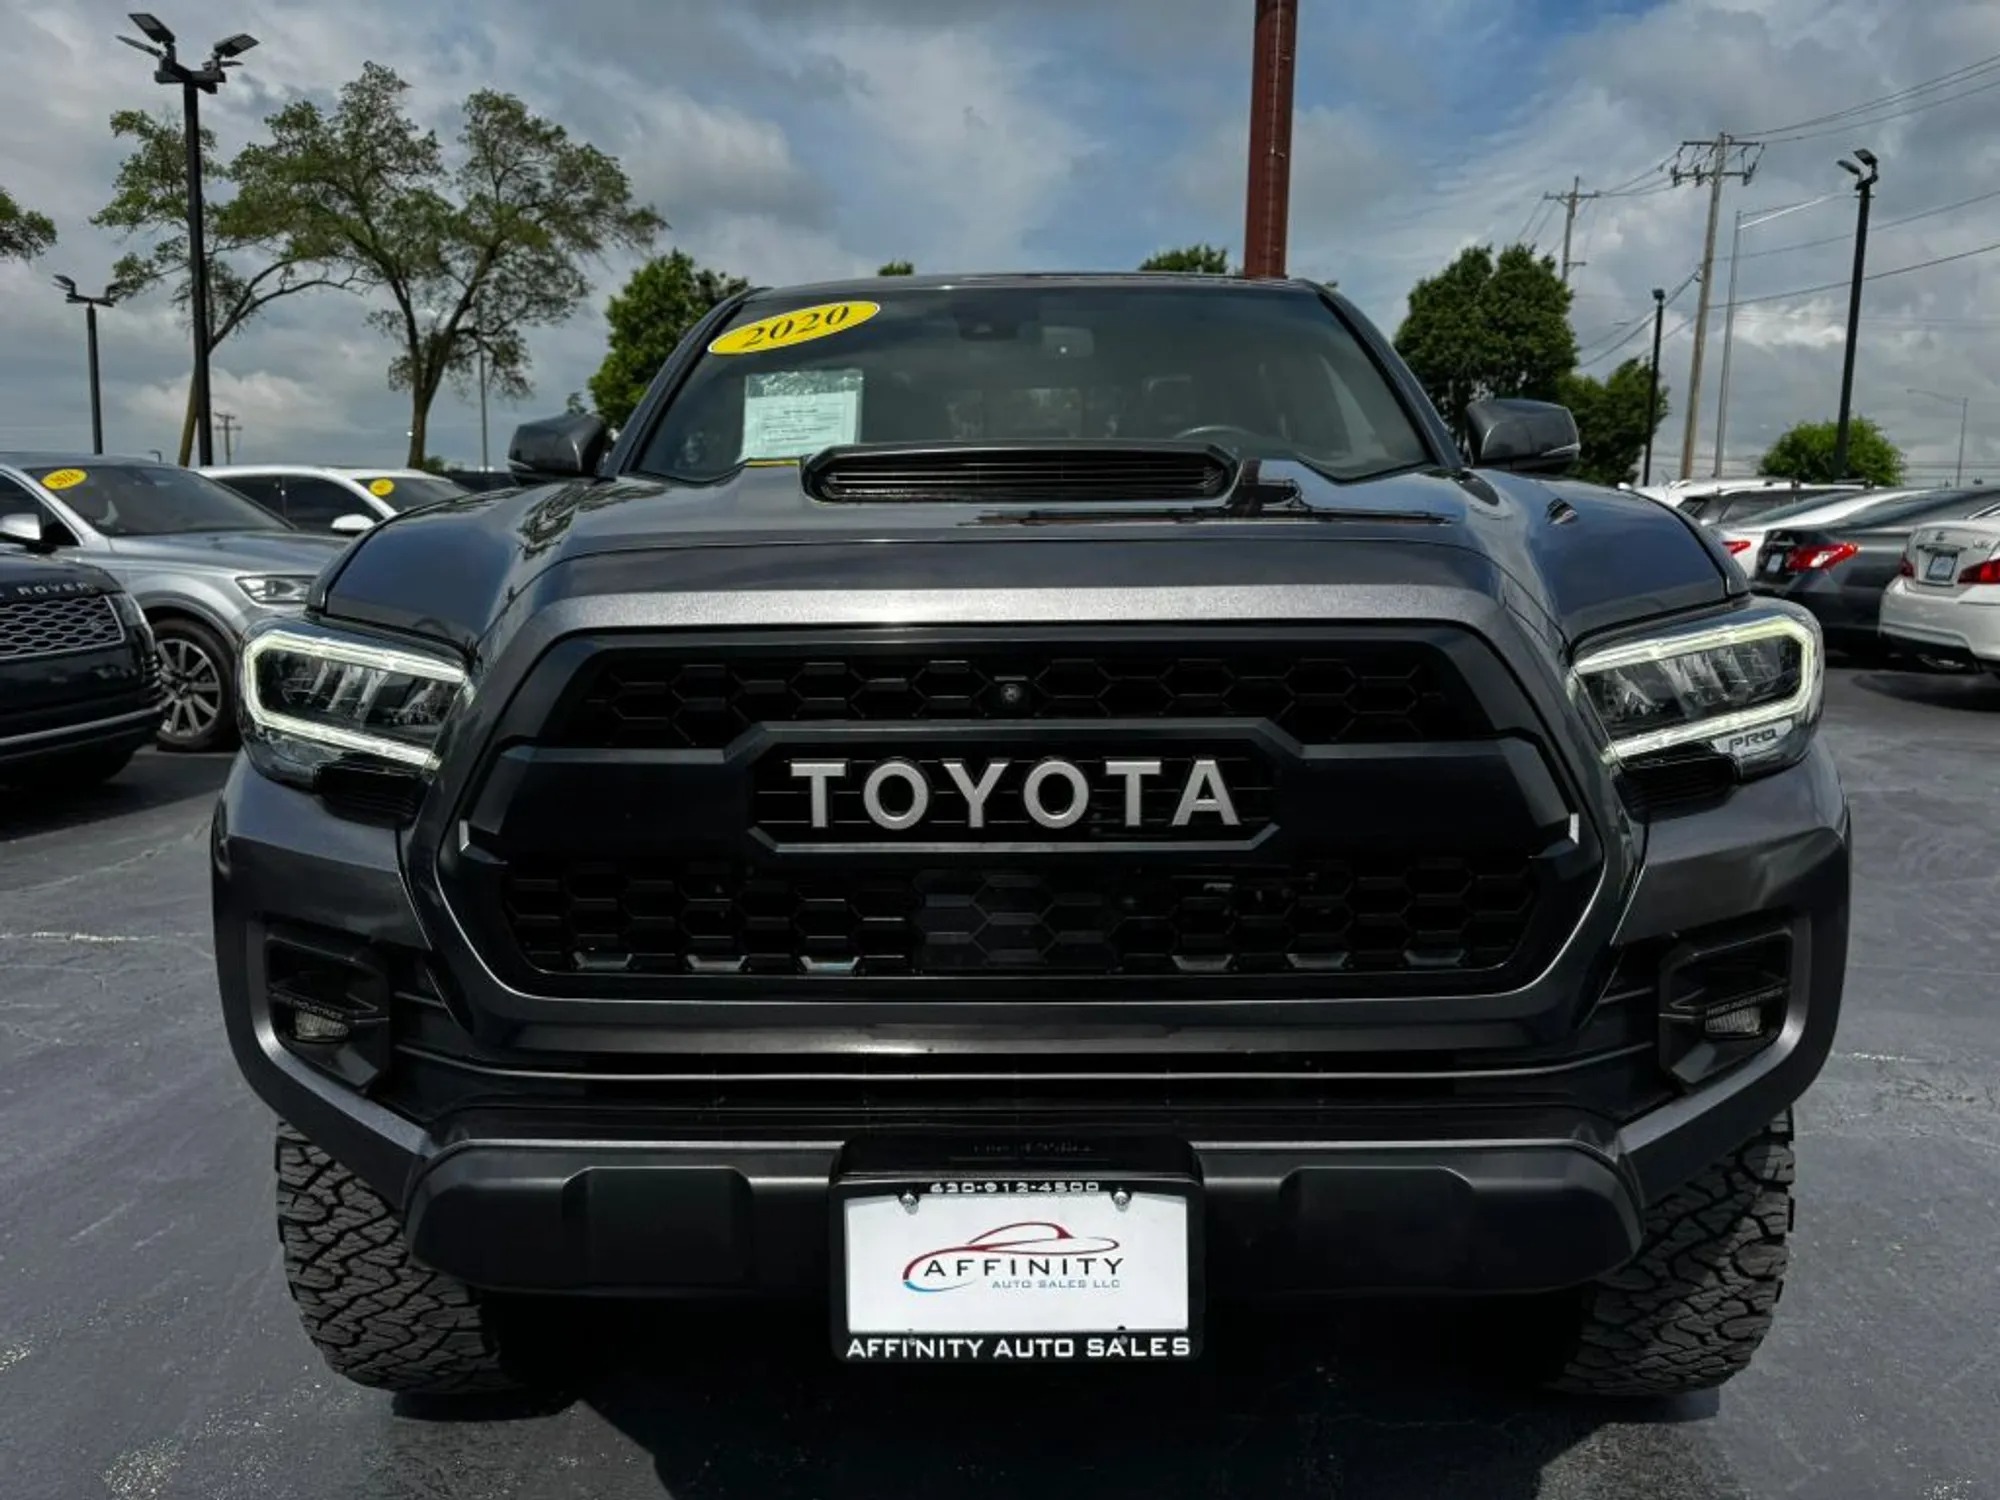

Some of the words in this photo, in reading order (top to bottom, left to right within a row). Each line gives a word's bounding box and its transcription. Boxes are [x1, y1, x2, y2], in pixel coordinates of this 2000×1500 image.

[742, 306, 849, 348] 2020
[1728, 728, 1777, 752] PRO
[790, 760, 1241, 830] TOYOTA
[930, 1182, 1100, 1193] 630-912-4500
[923, 1258, 1124, 1277] AFFINITY
[992, 1279, 1032, 1289] AUTO
[1038, 1279, 1088, 1289] SALES
[1094, 1279, 1121, 1289] LLC
[846, 1338, 984, 1359] AFFINITY
[993, 1337, 1074, 1358] AUTO
[1086, 1337, 1191, 1358] SALES
